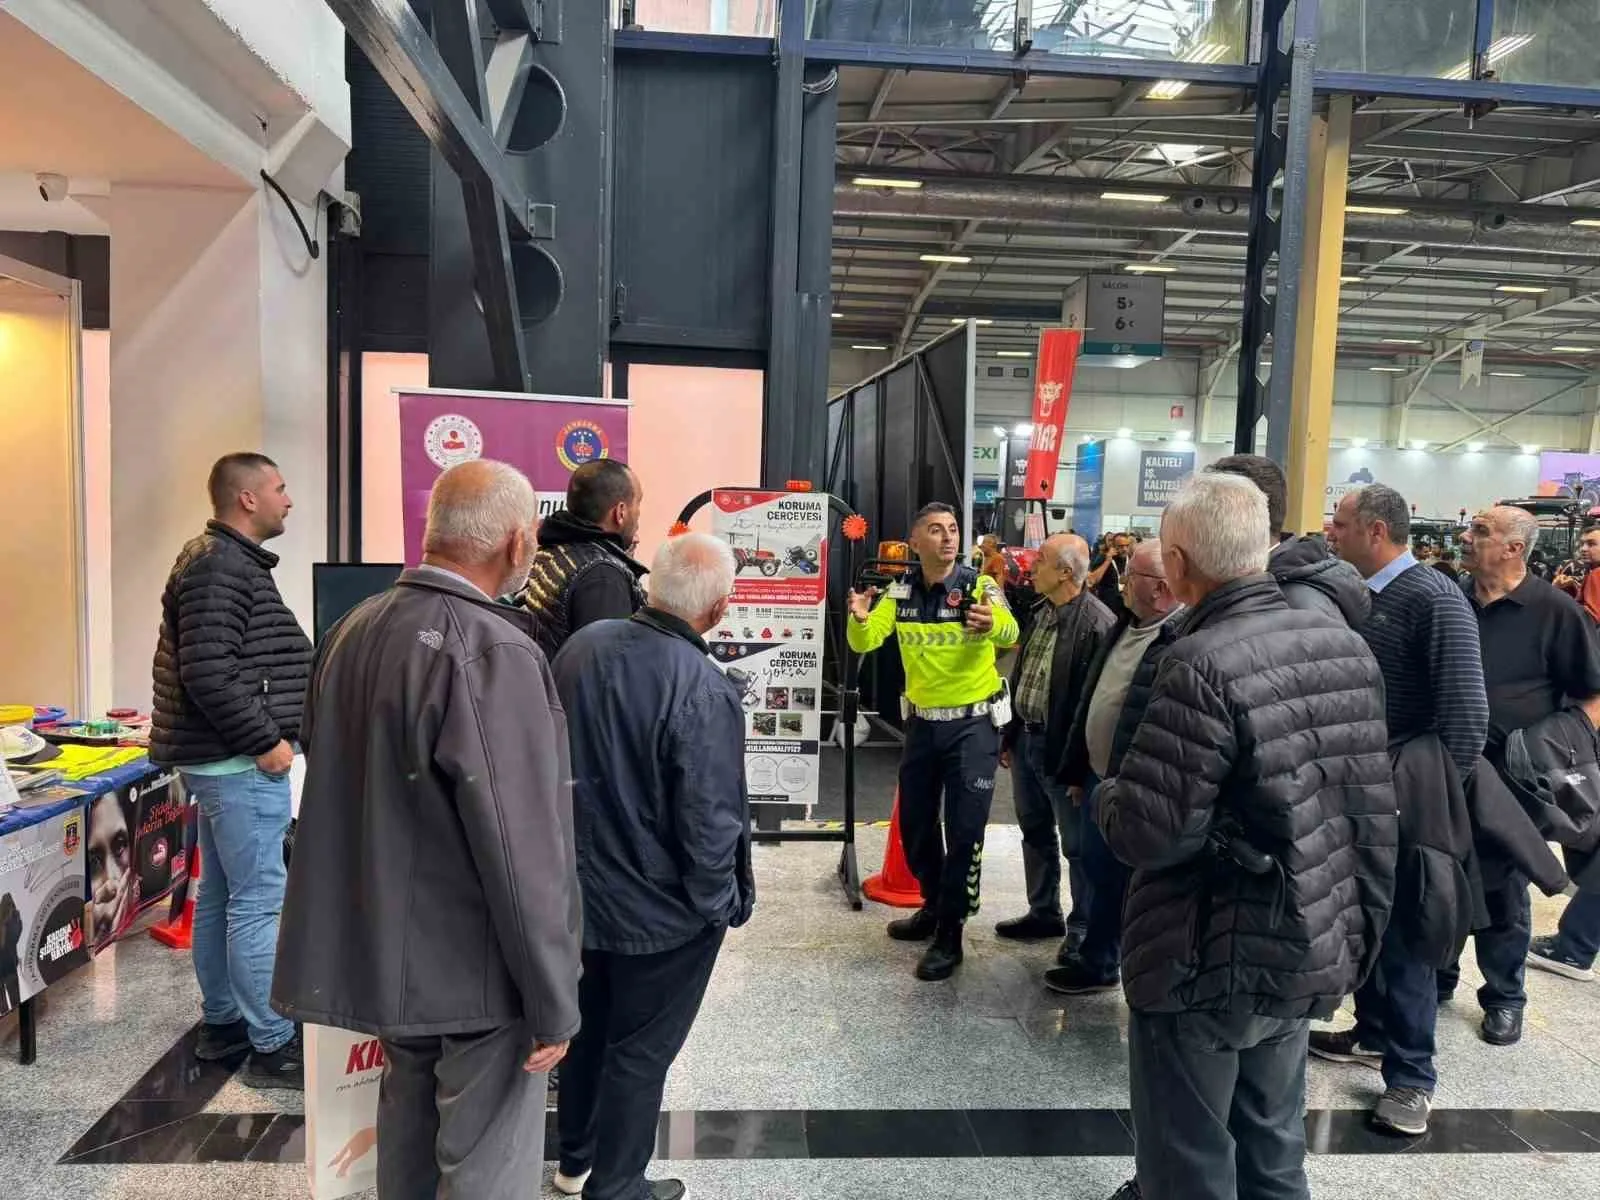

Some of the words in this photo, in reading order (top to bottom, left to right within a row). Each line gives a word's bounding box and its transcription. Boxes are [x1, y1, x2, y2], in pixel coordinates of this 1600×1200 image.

[1117, 296, 1127, 310] 5
[1115, 316, 1126, 330] 6
[778, 501, 822, 511] KORUMA
[779, 651, 817, 660] KORUMA
